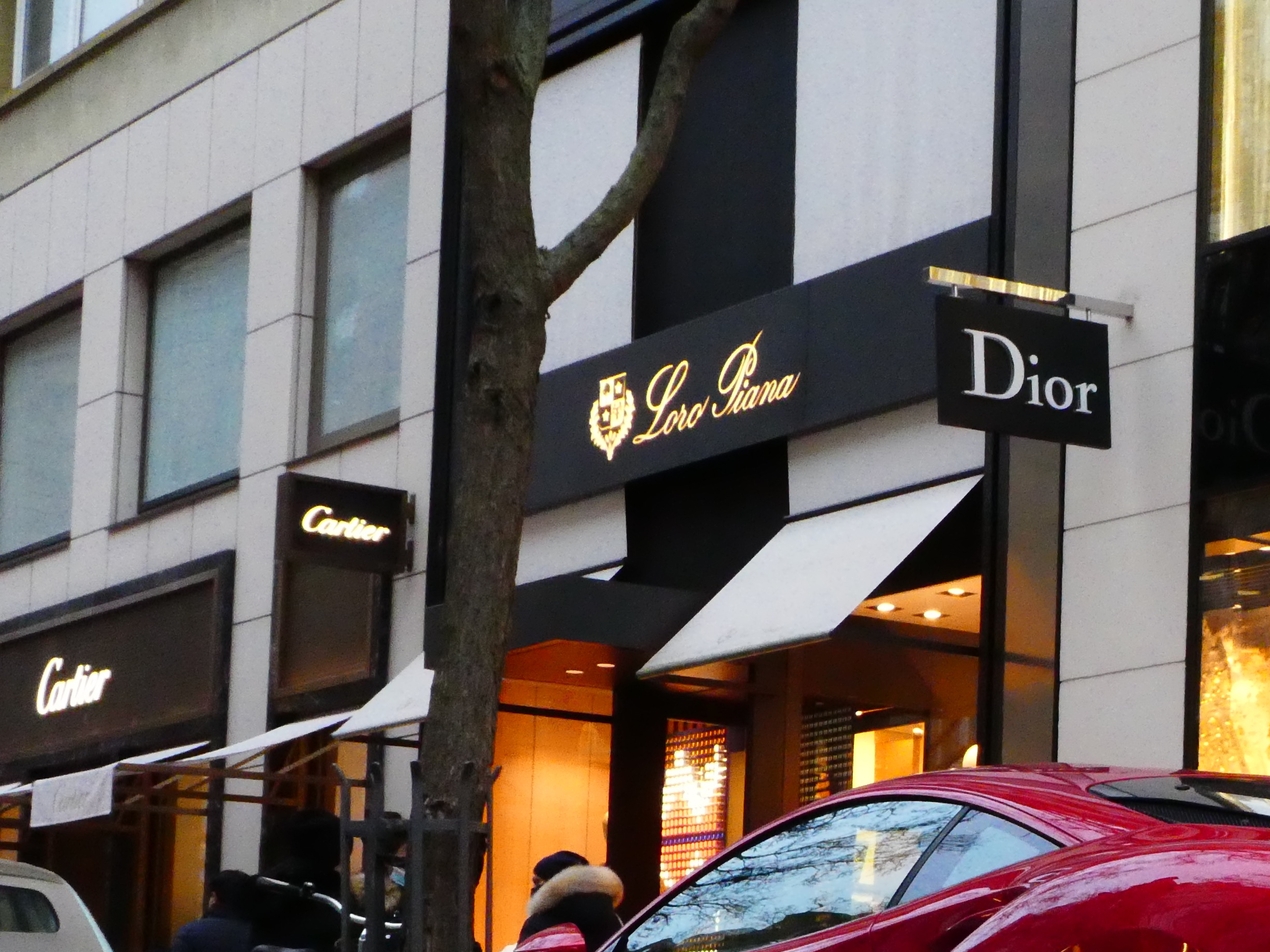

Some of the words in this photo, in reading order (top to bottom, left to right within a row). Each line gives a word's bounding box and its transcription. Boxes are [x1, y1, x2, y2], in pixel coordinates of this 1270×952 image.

[633, 360, 709, 445] Loro
[711, 331, 800, 418] Piana
[963, 328, 1098, 414] Dior
[302, 505, 391, 542] Cartier
[36, 656, 112, 716] Cartier
